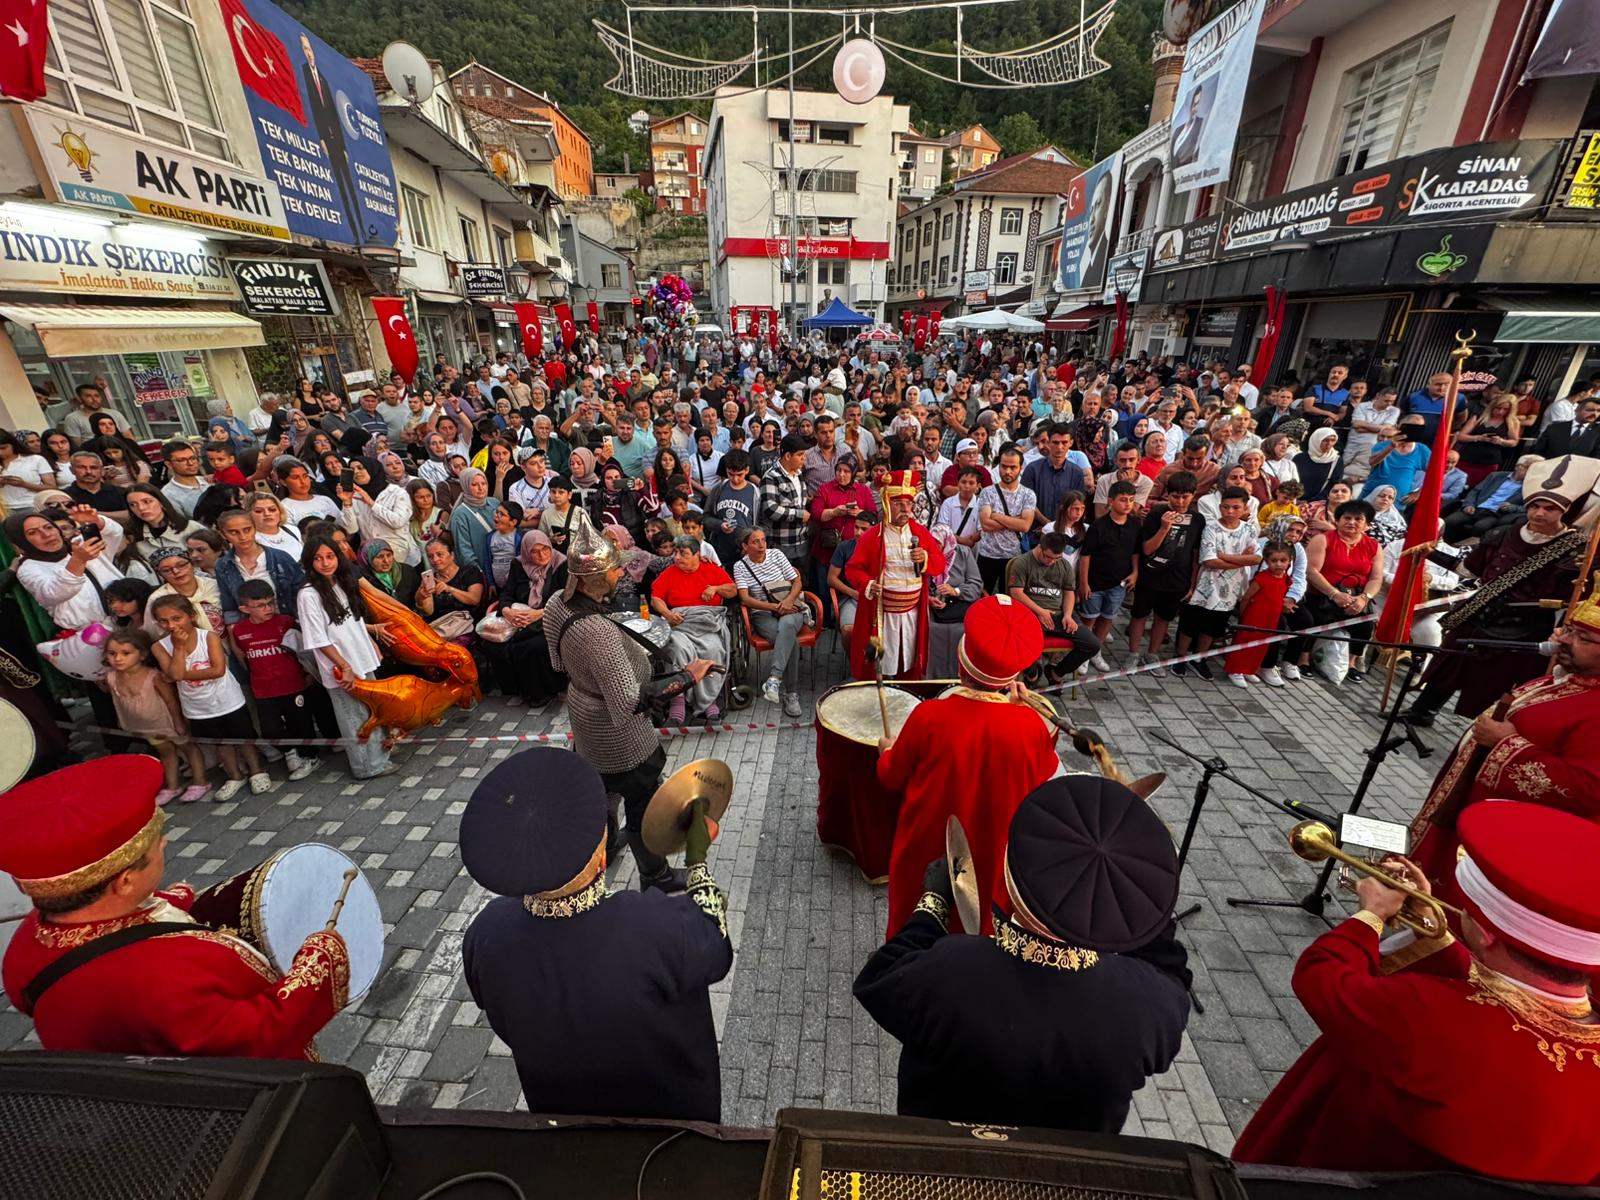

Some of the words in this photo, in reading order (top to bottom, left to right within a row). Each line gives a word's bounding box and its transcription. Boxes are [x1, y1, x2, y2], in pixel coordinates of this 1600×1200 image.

[258, 117, 285, 142] TEK
[285, 129, 322, 158] MİLLET
[135, 150, 192, 199] AK
[266, 144, 292, 167] TEK
[292, 155, 334, 183] BAYRAK
[1457, 155, 1522, 174] SİNAN
[74, 189, 90, 201] AK
[274, 170, 299, 191] TEK
[298, 177, 333, 202] VATAN
[1433, 175, 1530, 197] KARADAĞ
[281, 195, 306, 215] TEK
[305, 202, 342, 224] DEVLET
[1233, 208, 1271, 234] SİNAN
[1271, 187, 1339, 225] KARADAĞ
[1423, 200, 1464, 210] SİGORTA
[1464, 195, 1521, 208] ACENTELİĞİ
[102, 242, 229, 278] ŞEKERCİSİ
[60, 267, 129, 289] İmalattan
[129, 276, 165, 292] Halka
[241, 263, 315, 286] FINDIK
[478, 269, 503, 281] FINDIK
[716, 499, 750, 518] BROOKLYN
[246, 644, 286, 660] TÜRKİY
